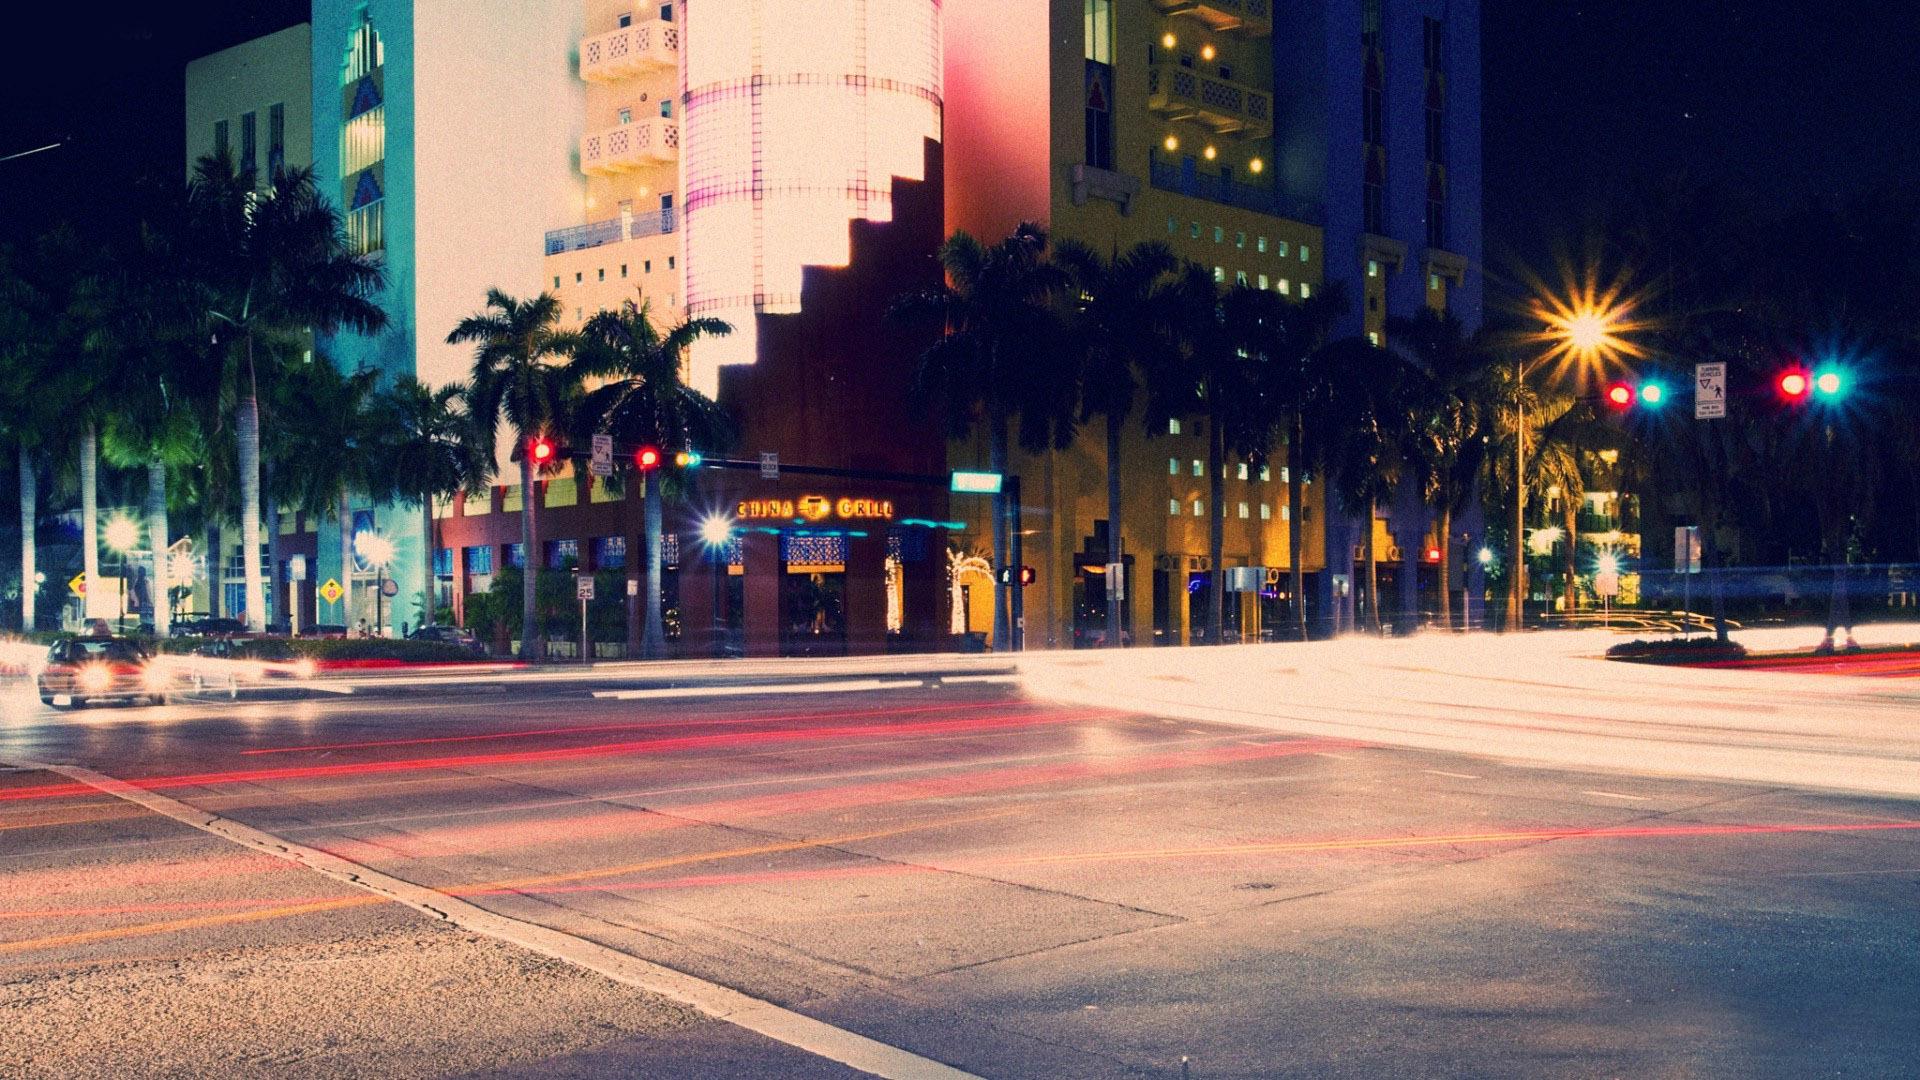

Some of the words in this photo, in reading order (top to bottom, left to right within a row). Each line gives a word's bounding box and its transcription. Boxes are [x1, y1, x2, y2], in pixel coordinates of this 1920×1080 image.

[737, 502, 792, 516] CHINA
[840, 501, 892, 516] GRILL
[580, 589, 593, 598] 25
